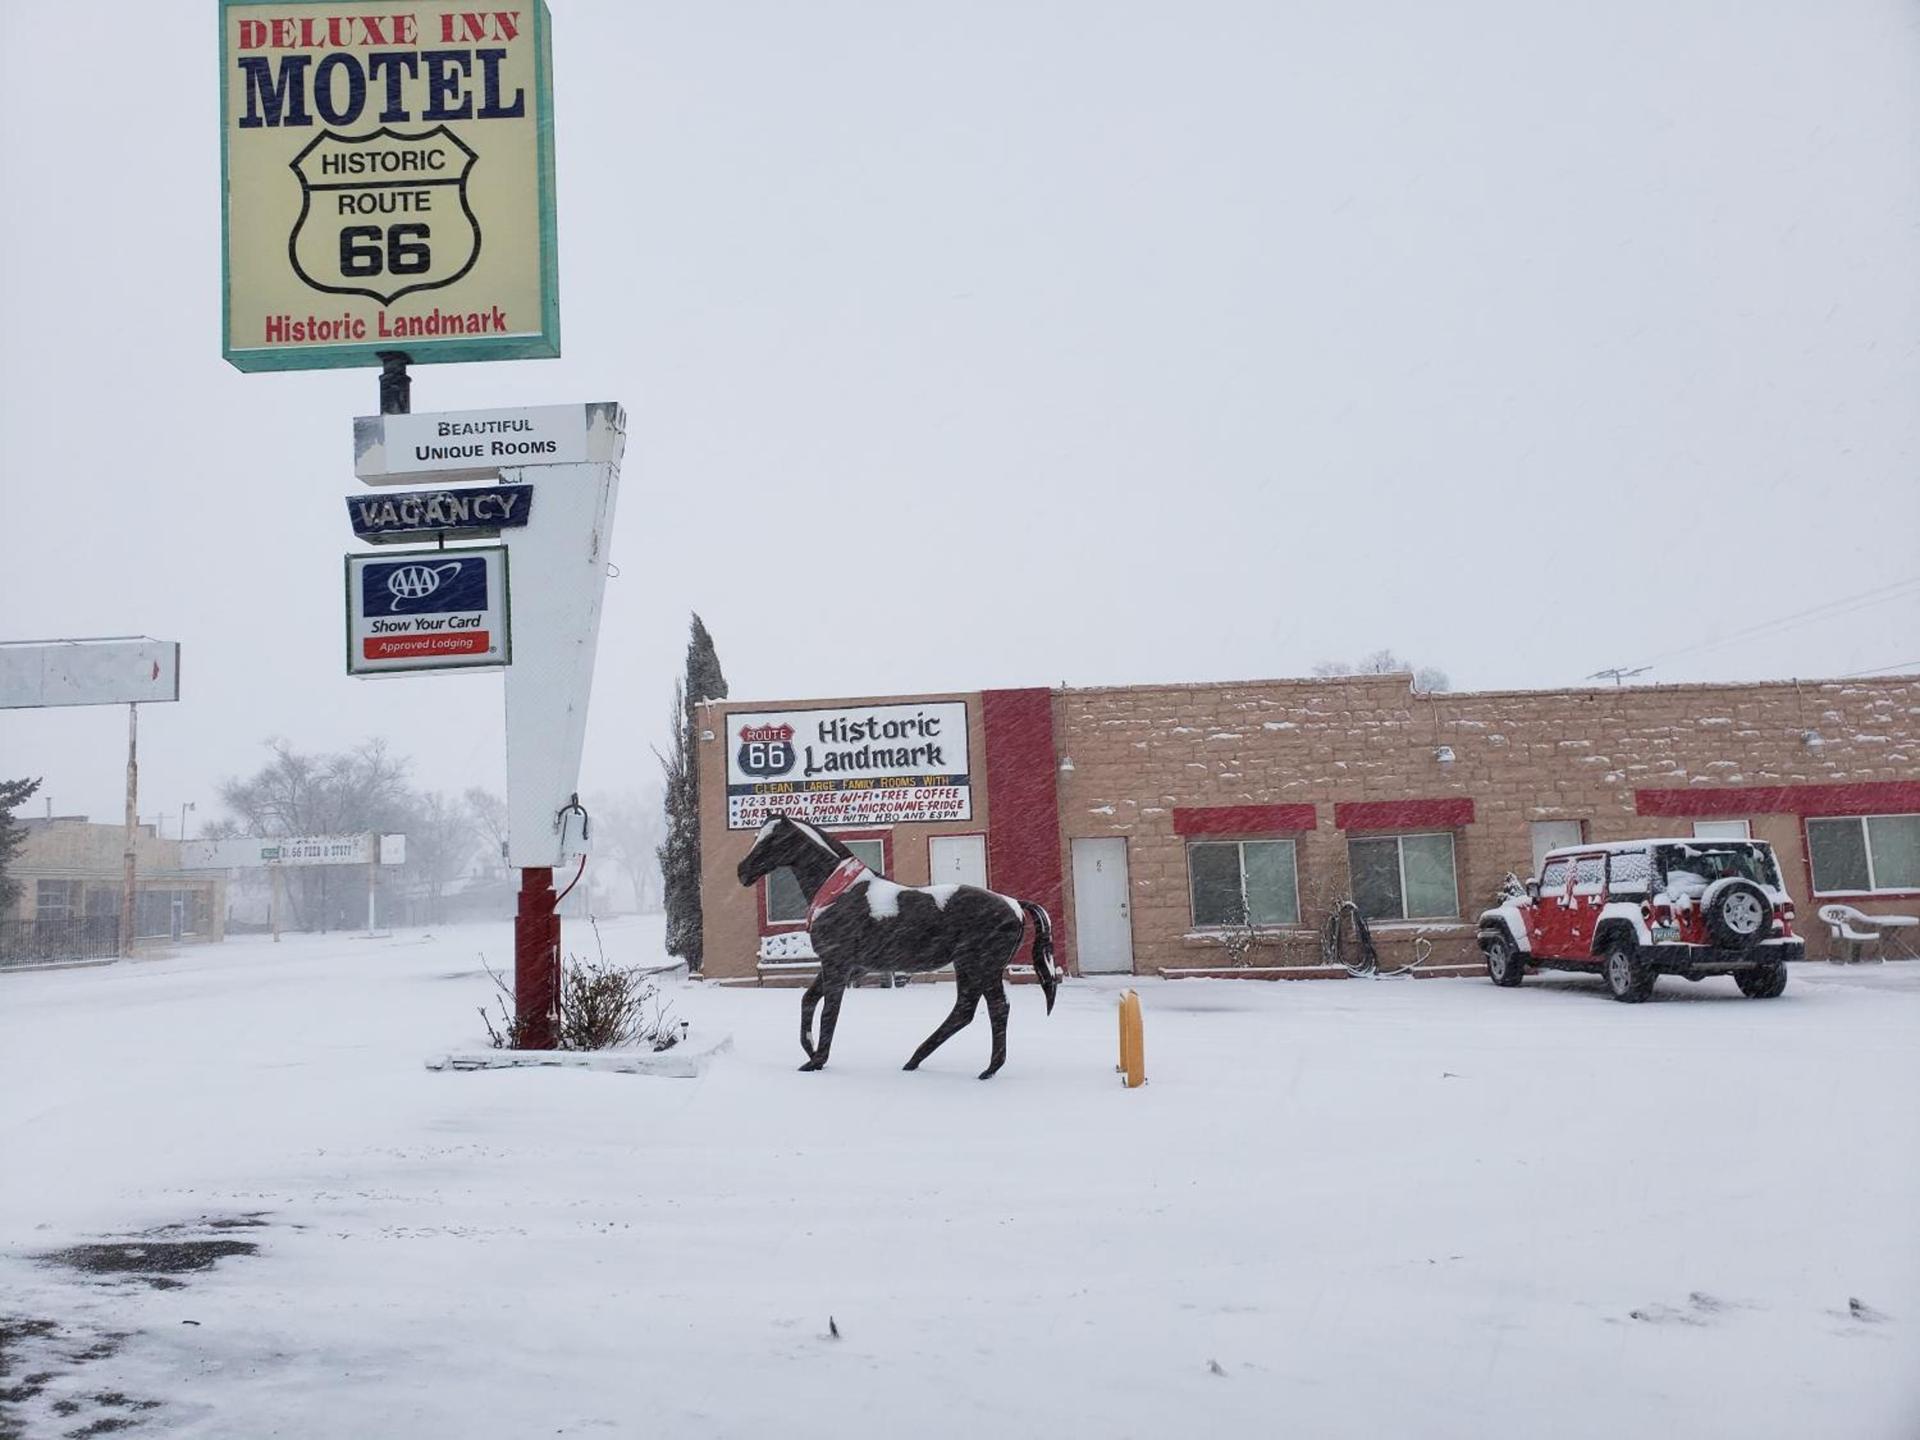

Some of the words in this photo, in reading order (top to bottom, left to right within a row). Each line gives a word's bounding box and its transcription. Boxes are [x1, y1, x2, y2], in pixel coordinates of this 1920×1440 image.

[238, 14, 418, 49] DELUXE
[440, 11, 520, 43] INN
[238, 48, 525, 128] MOTEL
[321, 149, 446, 174] HISTORIC
[338, 191, 431, 215] ROUTE
[340, 223, 431, 277] 66
[265, 313, 366, 343] Historic
[378, 306, 507, 338] Landmark
[437, 419, 534, 436] BEAUTIFUL
[415, 445, 484, 461] UNIQUE
[491, 440, 557, 456] ROOMS
[358, 493, 519, 528] VACANCY
[394, 567, 434, 597] AAA
[371, 620, 412, 634] Show
[415, 618, 446, 631] Your
[448, 614, 482, 629] Card
[379, 639, 429, 653] Approved
[431, 638, 474, 650] Lodging
[746, 728, 788, 741] ROUTE
[818, 711, 941, 744] Historic
[749, 743, 785, 768] 66
[803, 742, 947, 777] Landmark
[755, 782, 793, 794] CLEAN
[803, 780, 837, 792] LARGE
[843, 778, 875, 790] FAMILY
[881, 777, 916, 788] ROOMS
[922, 775, 949, 787] WITH
[769, 794, 801, 806] BEDS
[810, 793, 838, 805] FREE
[881, 789, 909, 801] FREE
[914, 788, 959, 800] COFFEE
[812, 804, 850, 815] PHONE
[857, 800, 964, 813] MICROWAVE-FRIDGE
[842, 813, 869, 823] WITH
[875, 812, 900, 821] HBO
[903, 811, 926, 820] AND
[929, 810, 959, 819] ESPN
